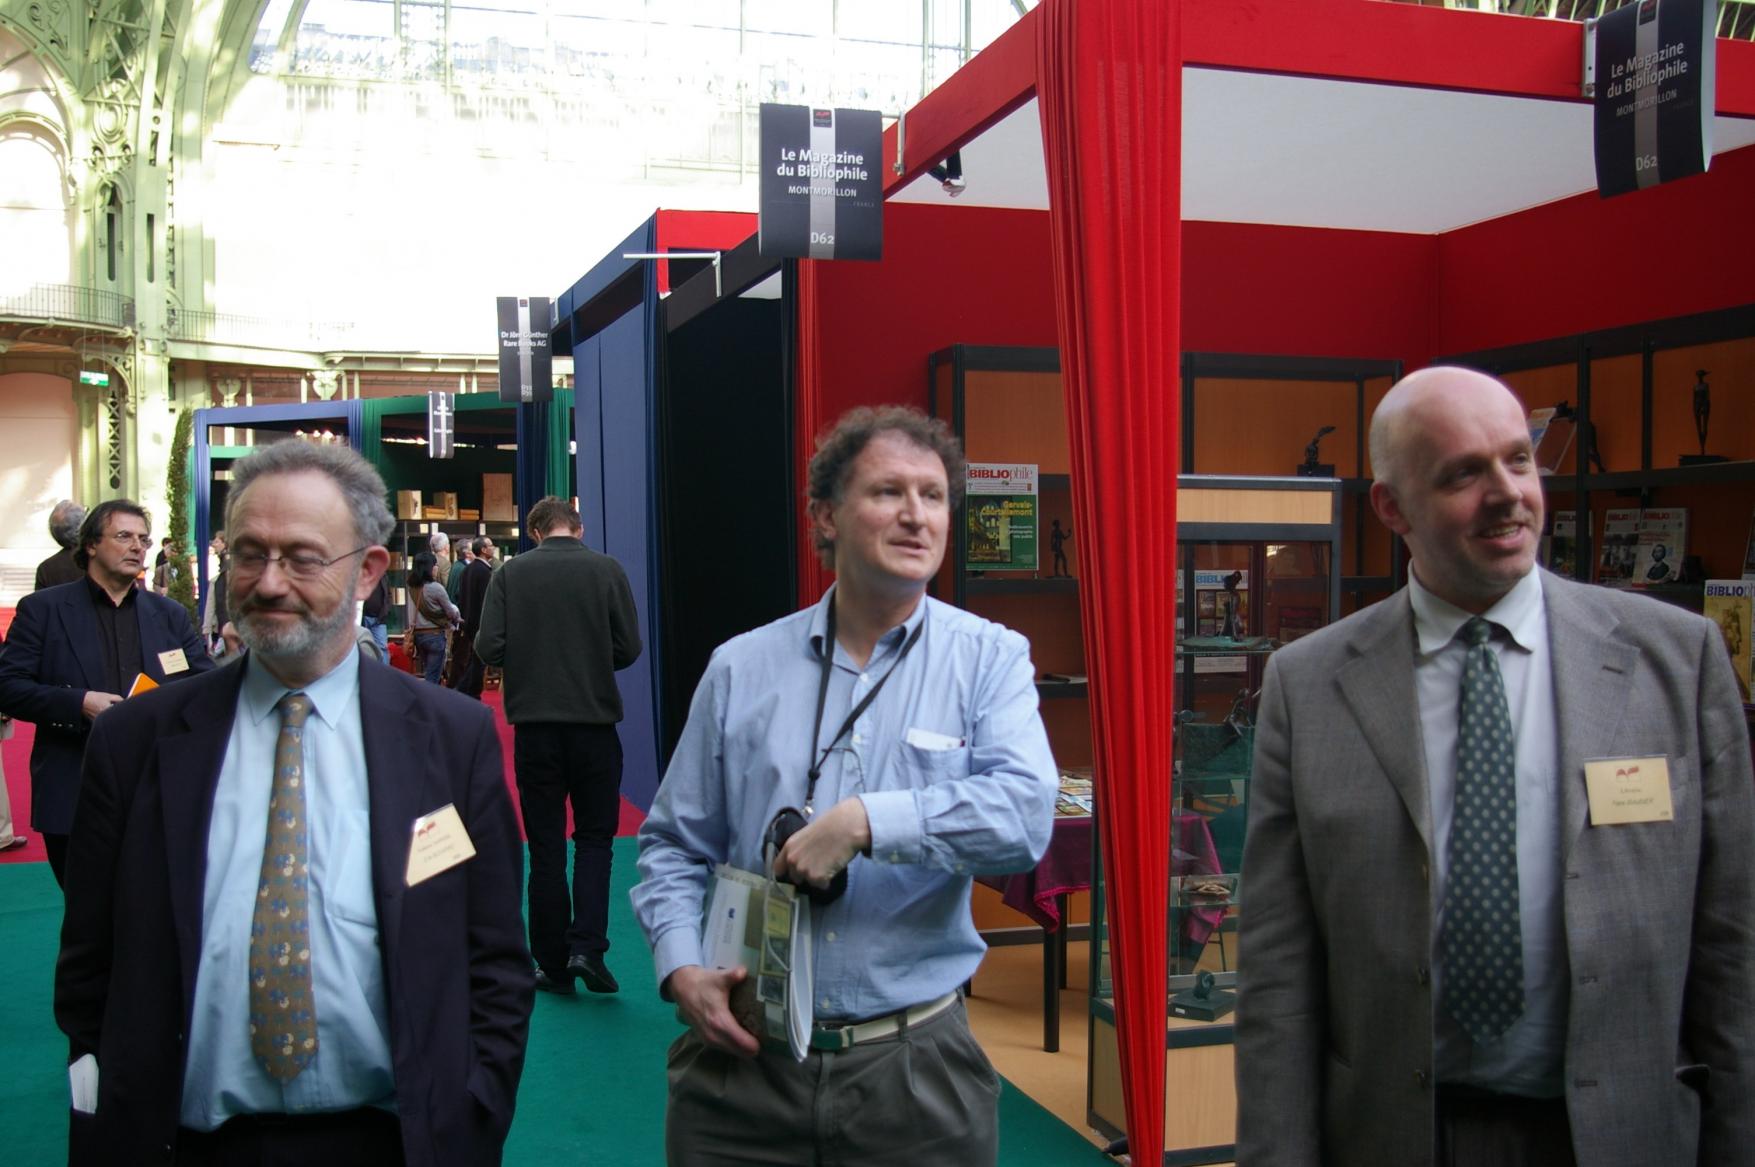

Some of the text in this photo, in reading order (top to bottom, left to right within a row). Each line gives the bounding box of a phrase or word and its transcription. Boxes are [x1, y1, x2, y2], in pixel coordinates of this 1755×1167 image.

[1611, 42, 1684, 78] Le Magazine
[1607, 60, 1688, 98] du Bibliophile
[781, 147, 864, 166] Le Magazine
[1635, 155, 1657, 171] D62
[776, 162, 868, 182] du Bibliophile
[788, 185, 857, 197] MONTMORILLON
[810, 232, 834, 245] D62
